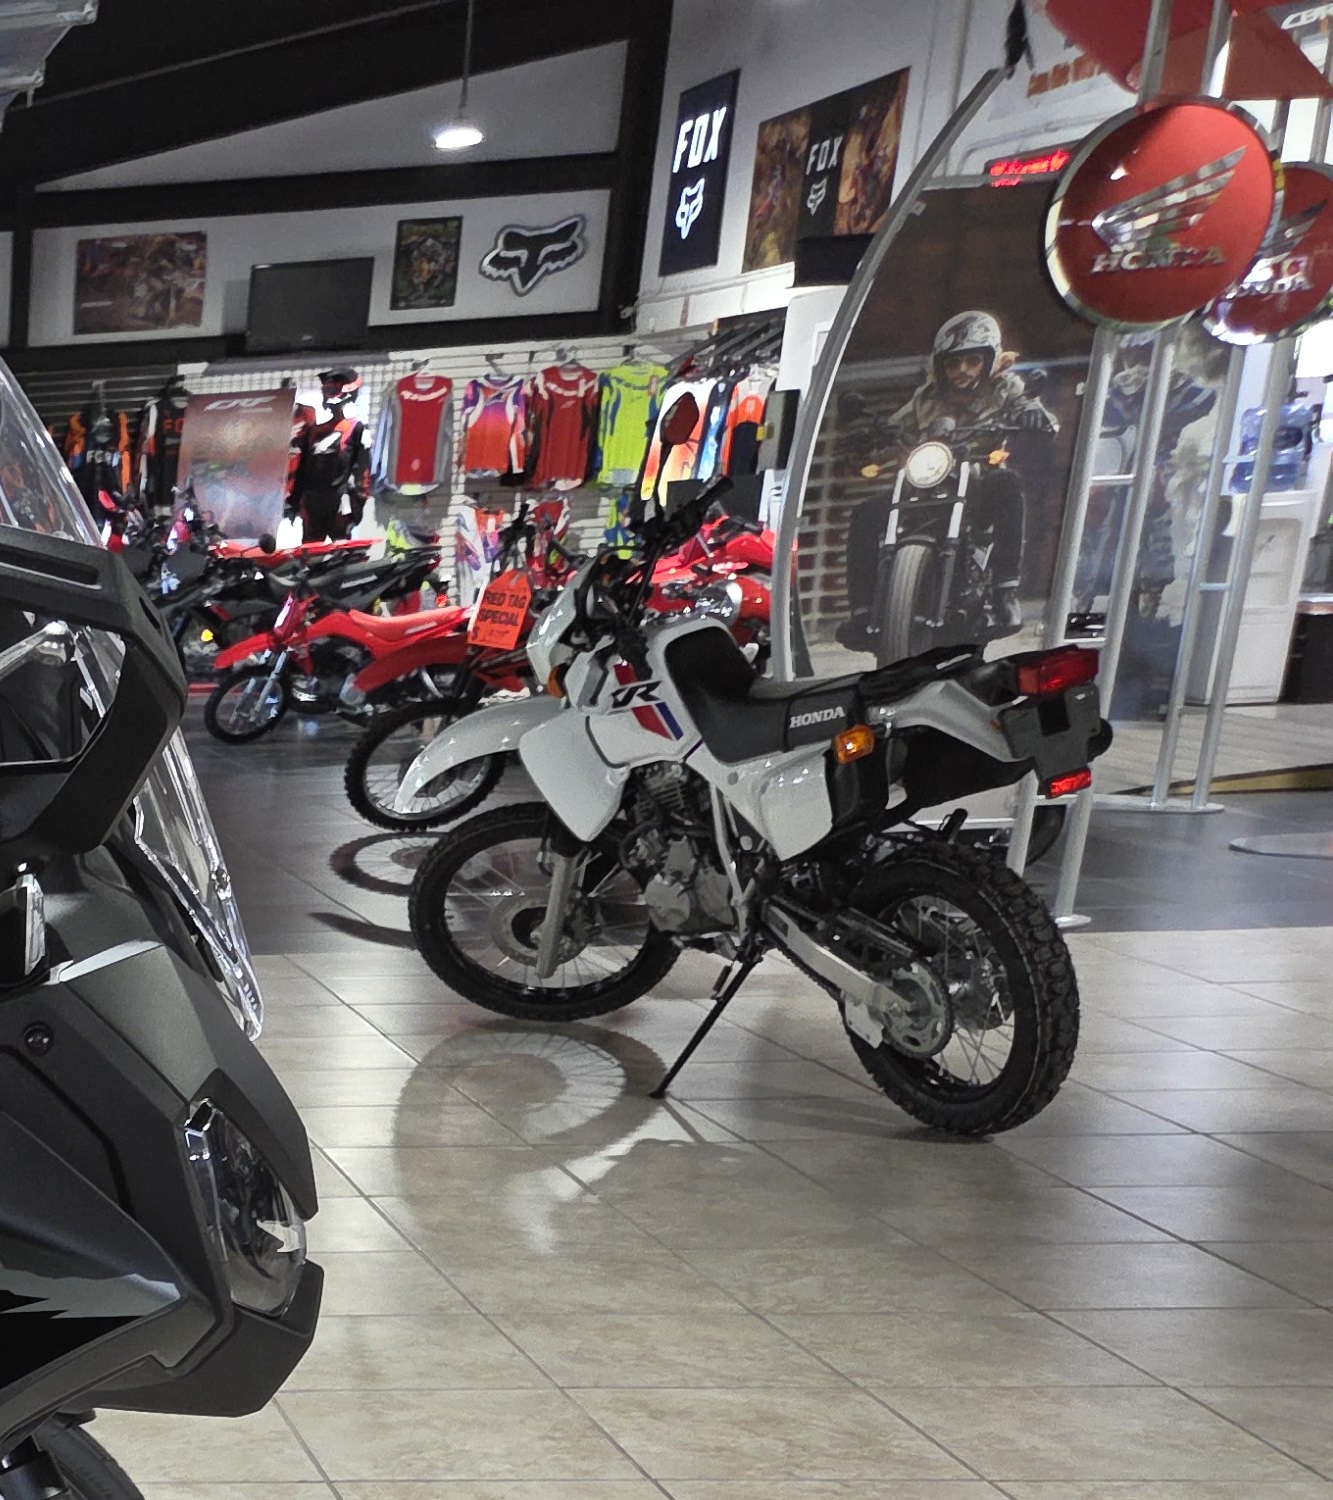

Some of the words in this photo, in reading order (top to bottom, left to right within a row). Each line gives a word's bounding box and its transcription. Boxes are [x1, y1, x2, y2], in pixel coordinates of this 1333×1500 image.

[672, 106, 727, 174] FOX
[806, 136, 843, 175] FOX
[789, 706, 845, 729] HONDA
